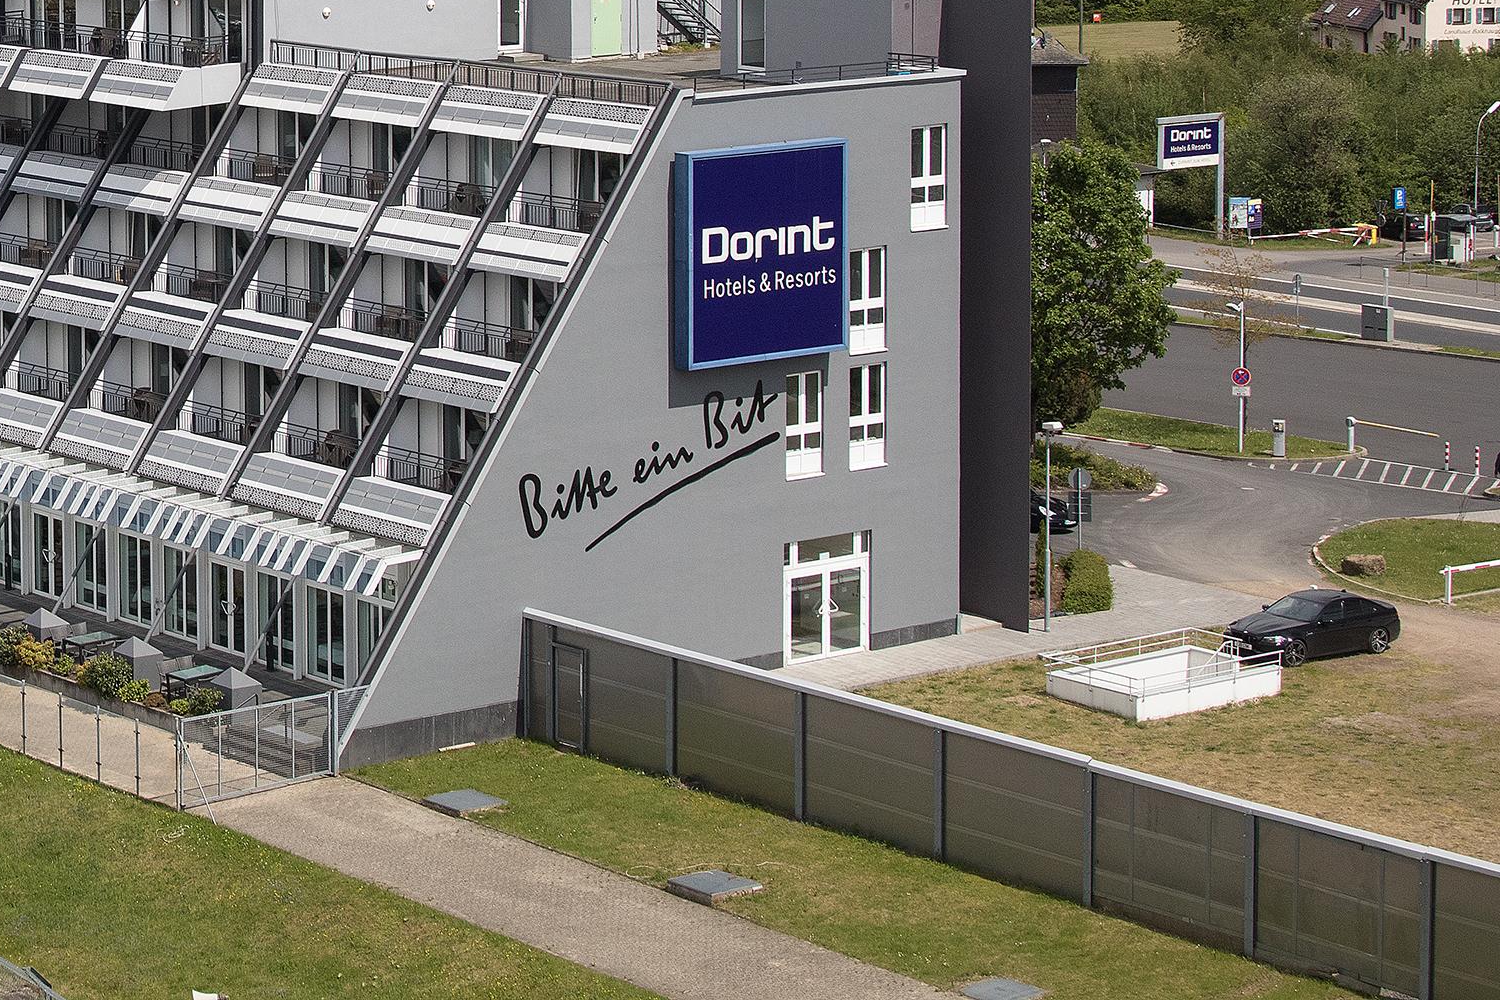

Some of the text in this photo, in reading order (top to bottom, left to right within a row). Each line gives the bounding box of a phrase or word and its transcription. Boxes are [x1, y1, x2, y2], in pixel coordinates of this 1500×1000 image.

[1170, 126, 1212, 142] Dorint
[1170, 145, 1186, 153] Hotels
[1191, 143, 1211, 151] Resorts
[702, 215, 835, 265] Dorint
[703, 266, 836, 299] Hotels & Resorts
[519, 379, 778, 539] Bitte ein Bit
